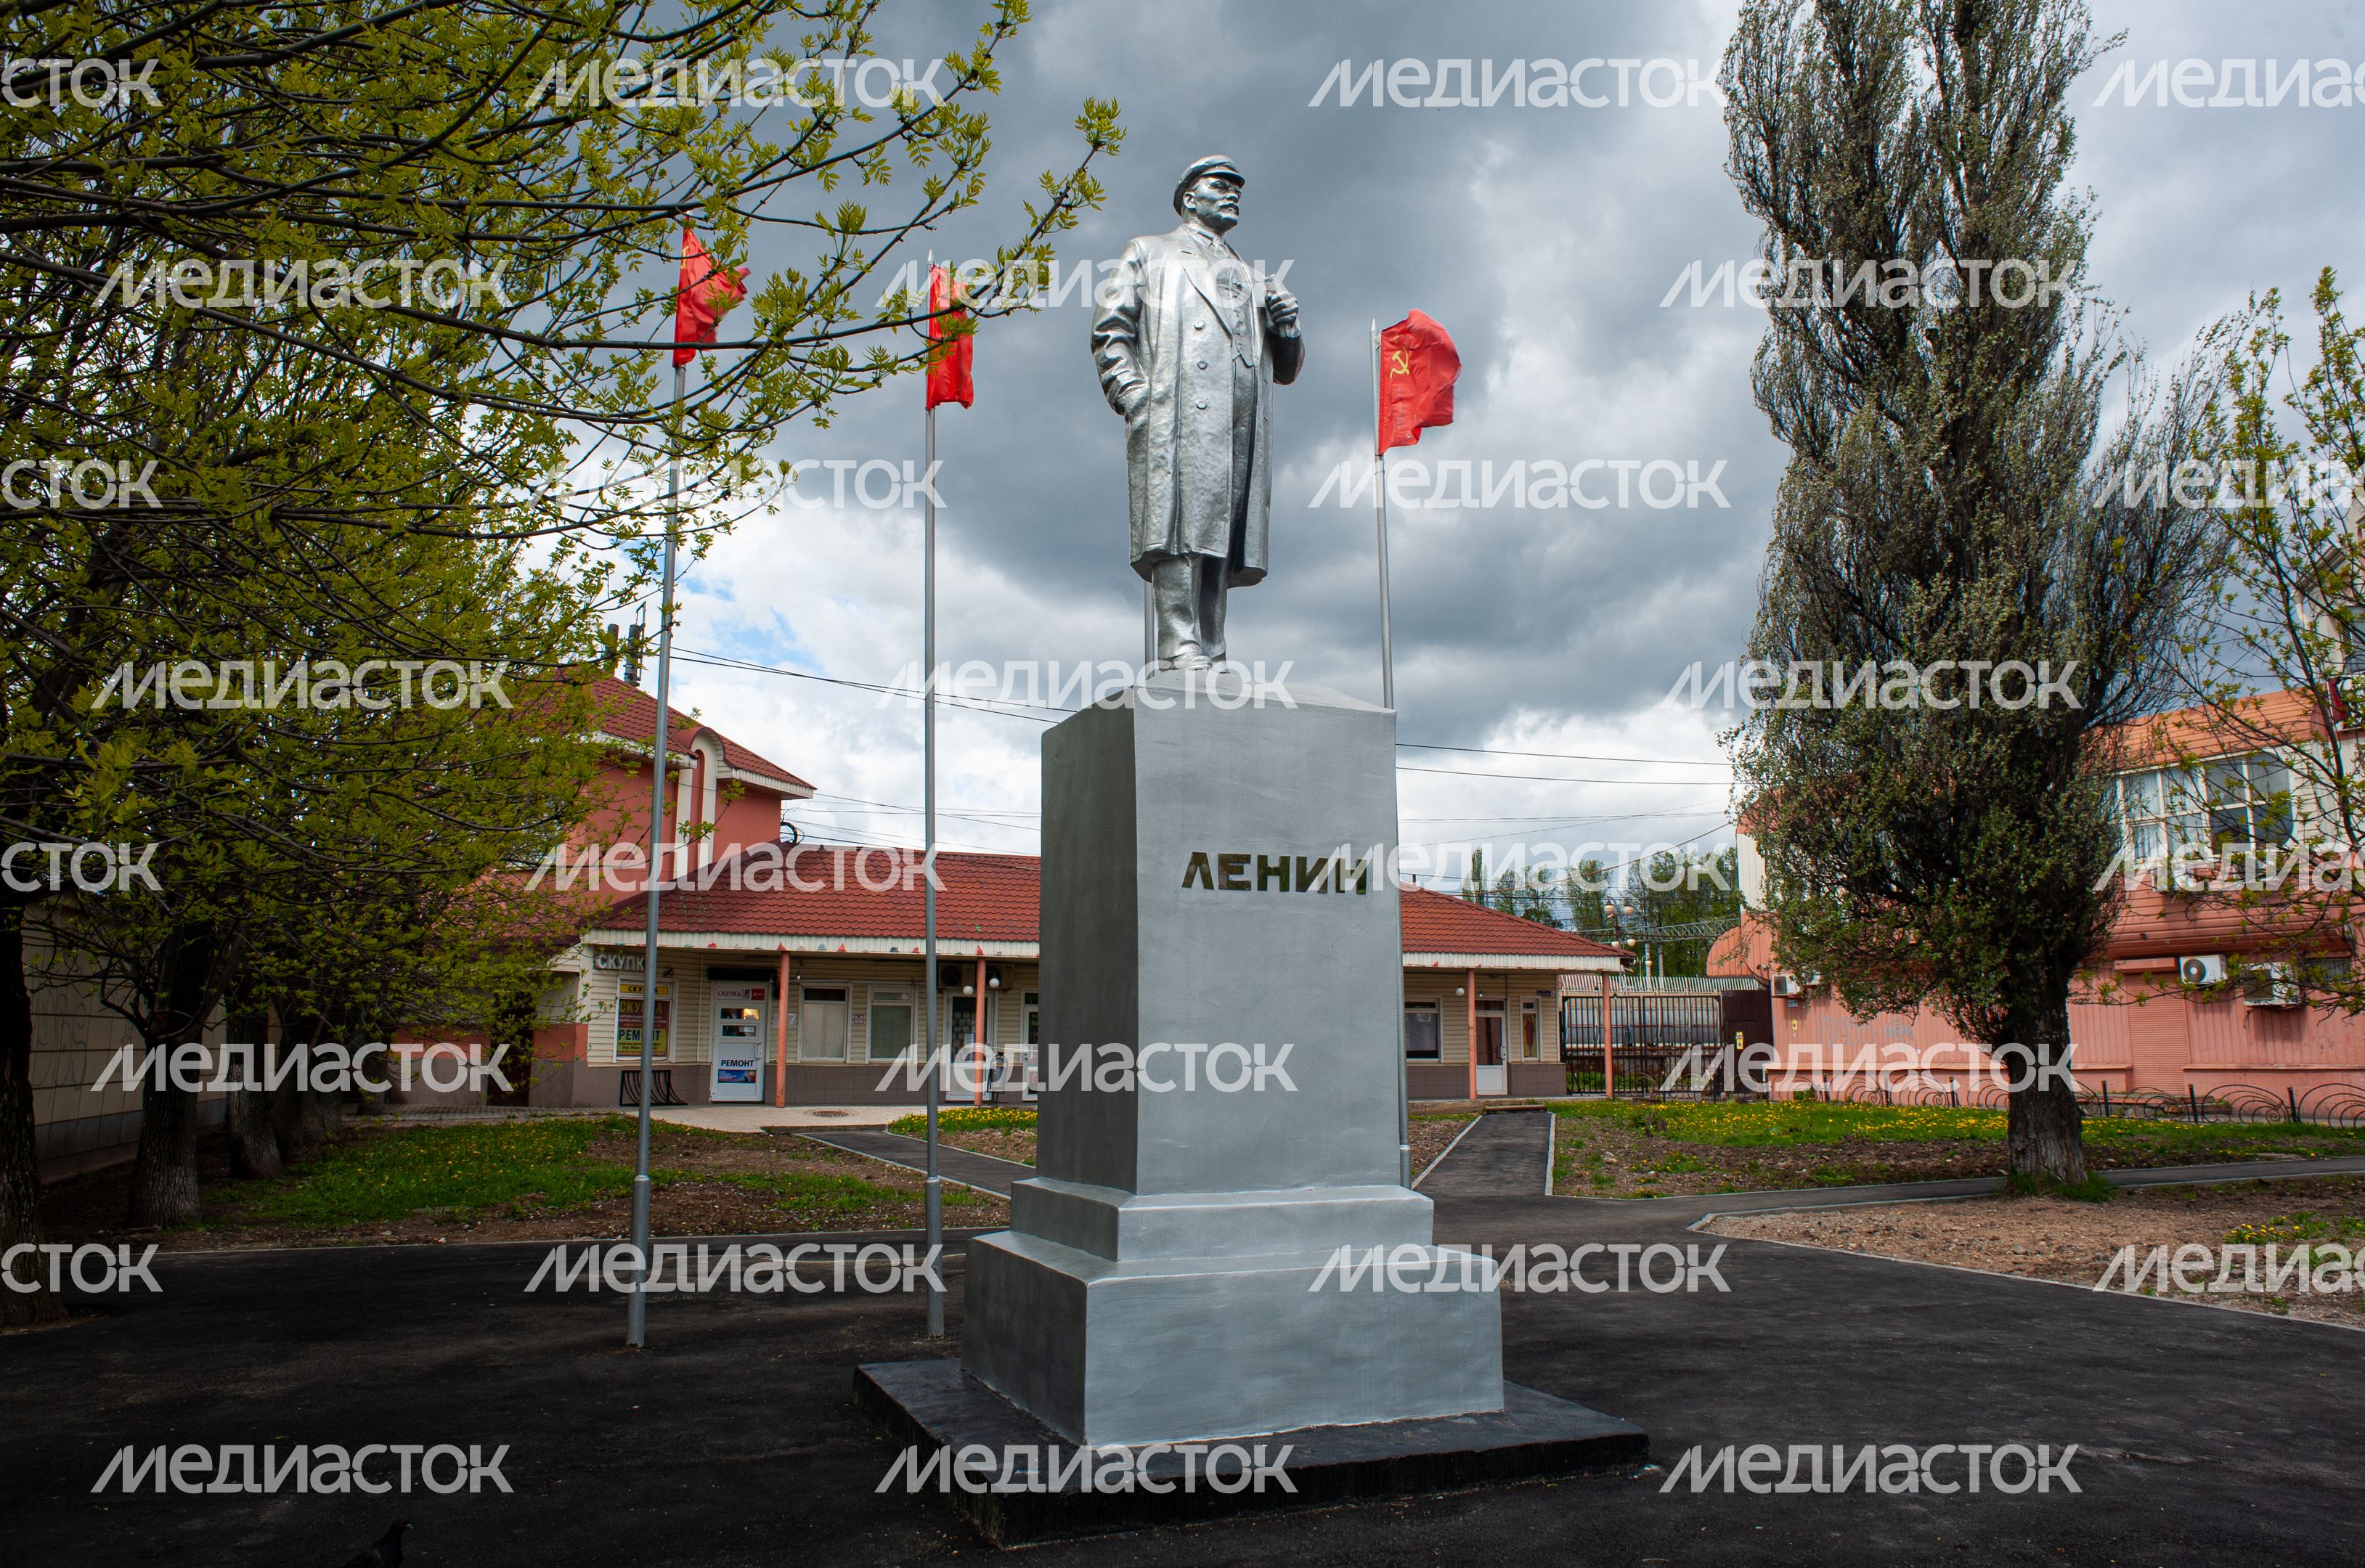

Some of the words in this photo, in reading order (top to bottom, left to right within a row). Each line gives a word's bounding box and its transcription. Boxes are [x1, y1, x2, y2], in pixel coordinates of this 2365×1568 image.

[1181, 851, 1367, 894] ЛЕНИН
[595, 953, 645, 971] СКУПК
[619, 1001, 662, 1014] СКУА
[619, 1029, 661, 1041] РЕМТ
